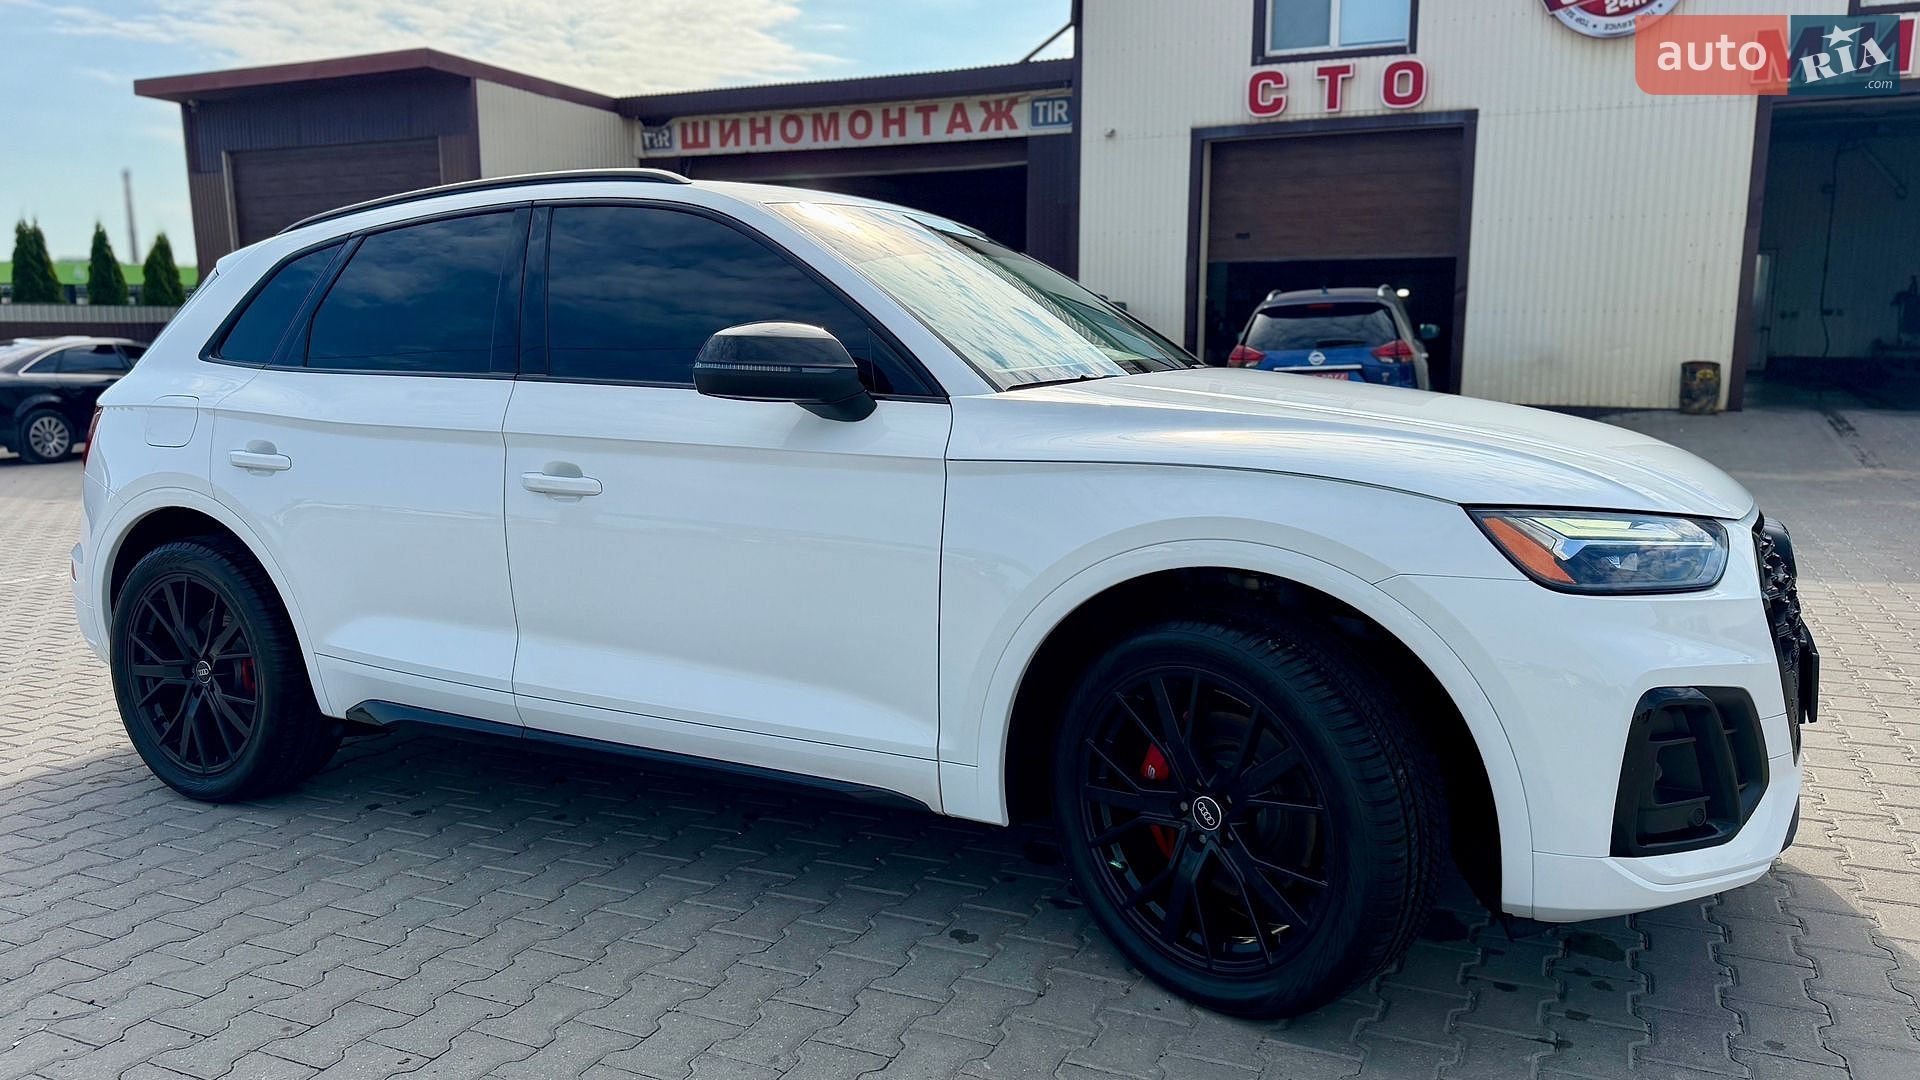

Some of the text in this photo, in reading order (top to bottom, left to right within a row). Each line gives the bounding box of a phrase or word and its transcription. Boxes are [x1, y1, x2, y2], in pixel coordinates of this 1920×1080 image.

[1033, 100, 1069, 124] TIR
[1248, 58, 1428, 118] СТО
[680, 98, 1020, 150] ШИНОМОНТАЖ
